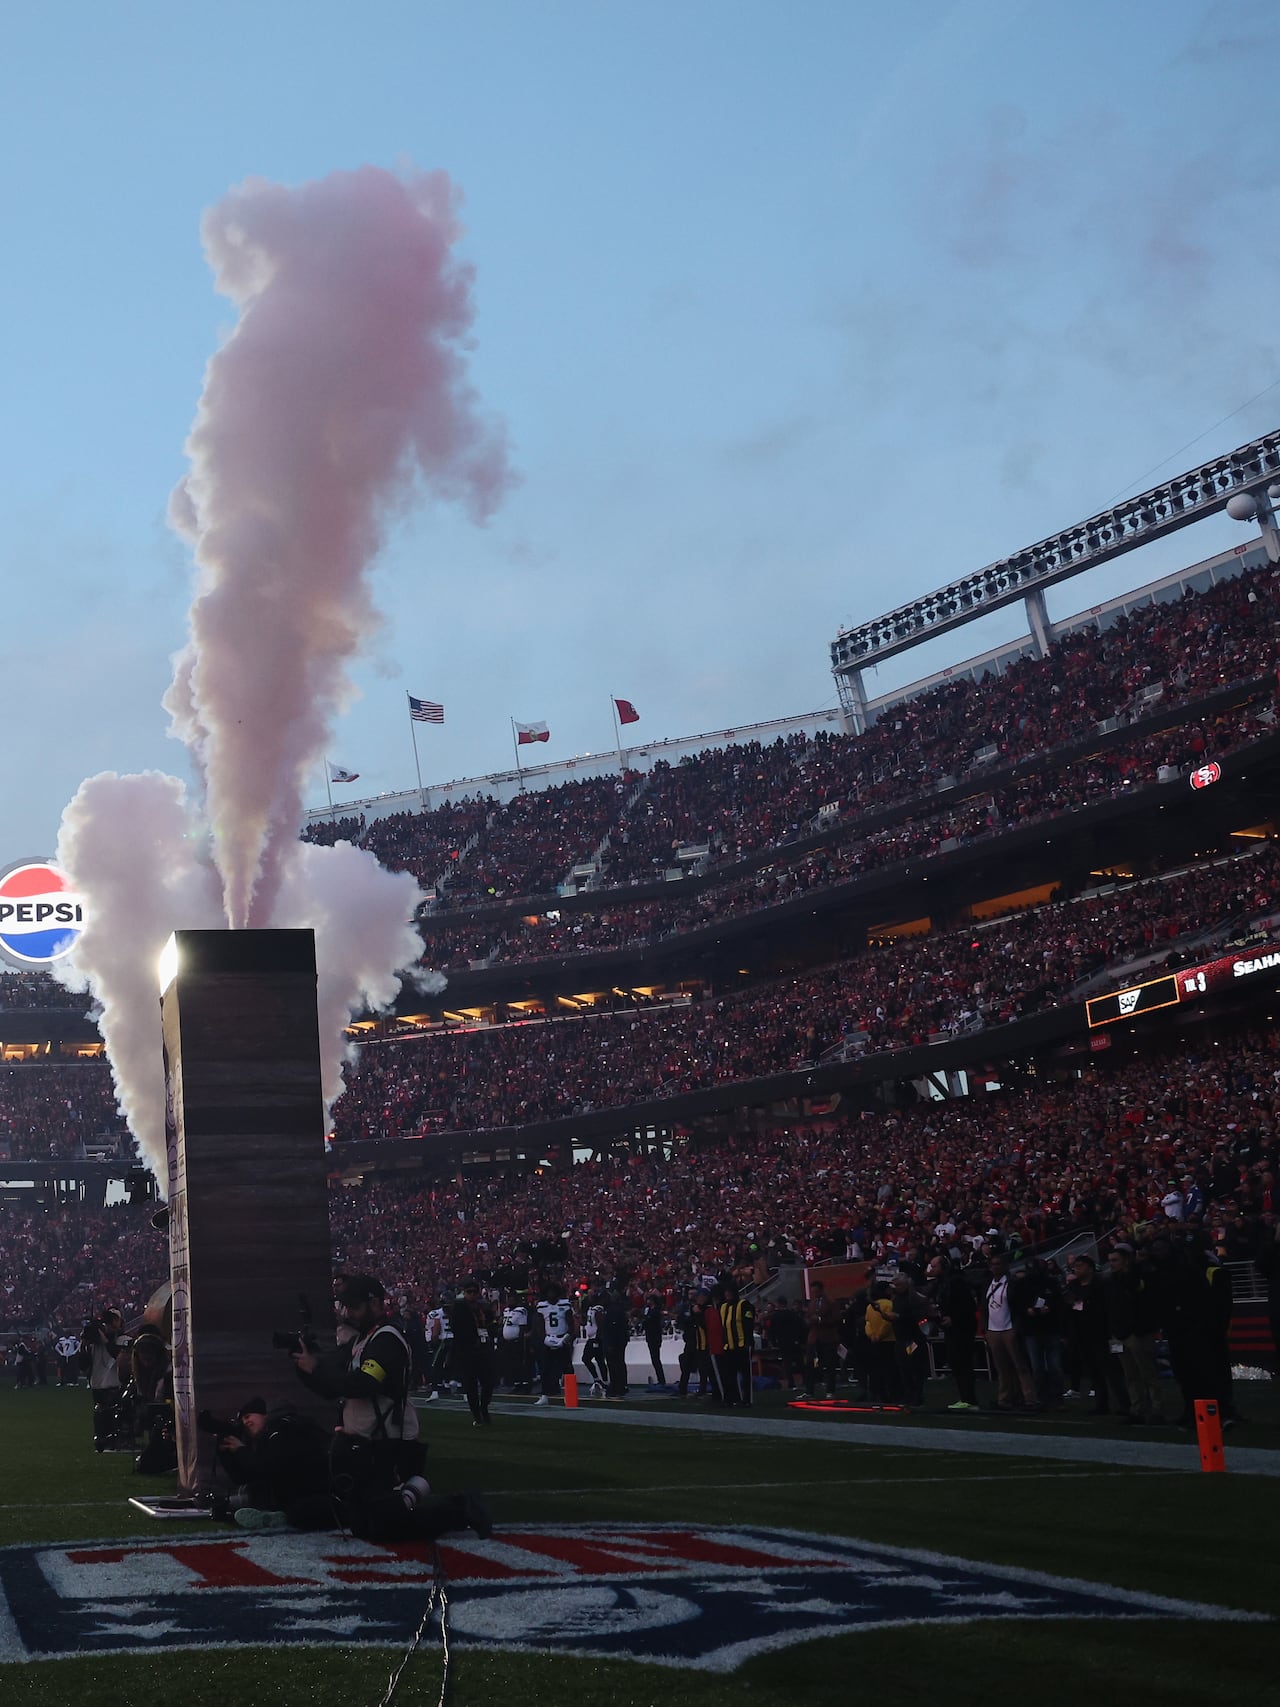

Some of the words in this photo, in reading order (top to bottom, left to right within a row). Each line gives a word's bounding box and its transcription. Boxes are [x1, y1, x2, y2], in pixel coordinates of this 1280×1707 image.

[1197, 972, 1207, 992] 3
[1120, 995, 1135, 1009] SAP
[549, 1313, 558, 1327] 6
